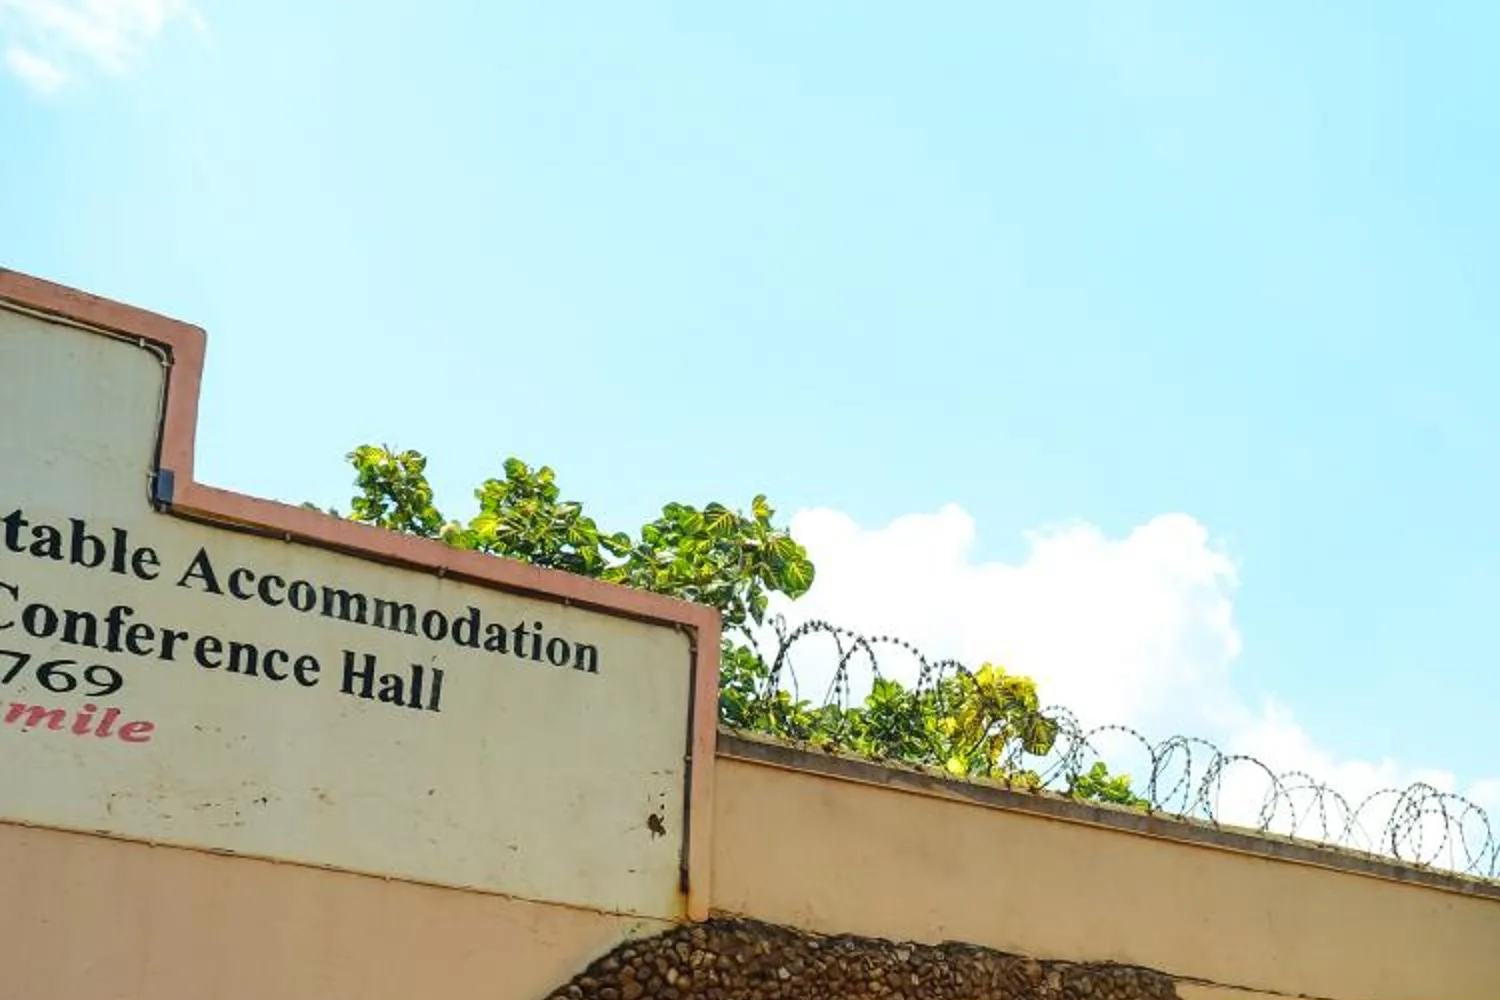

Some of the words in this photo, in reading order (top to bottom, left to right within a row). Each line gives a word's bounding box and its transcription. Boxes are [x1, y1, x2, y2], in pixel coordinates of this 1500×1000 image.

[0, 509, 160, 580] table
[179, 547, 600, 674] Accommodation
[0, 650, 123, 697] 769
[340, 650, 444, 713] Hall
[4, 702, 155, 744] mile
